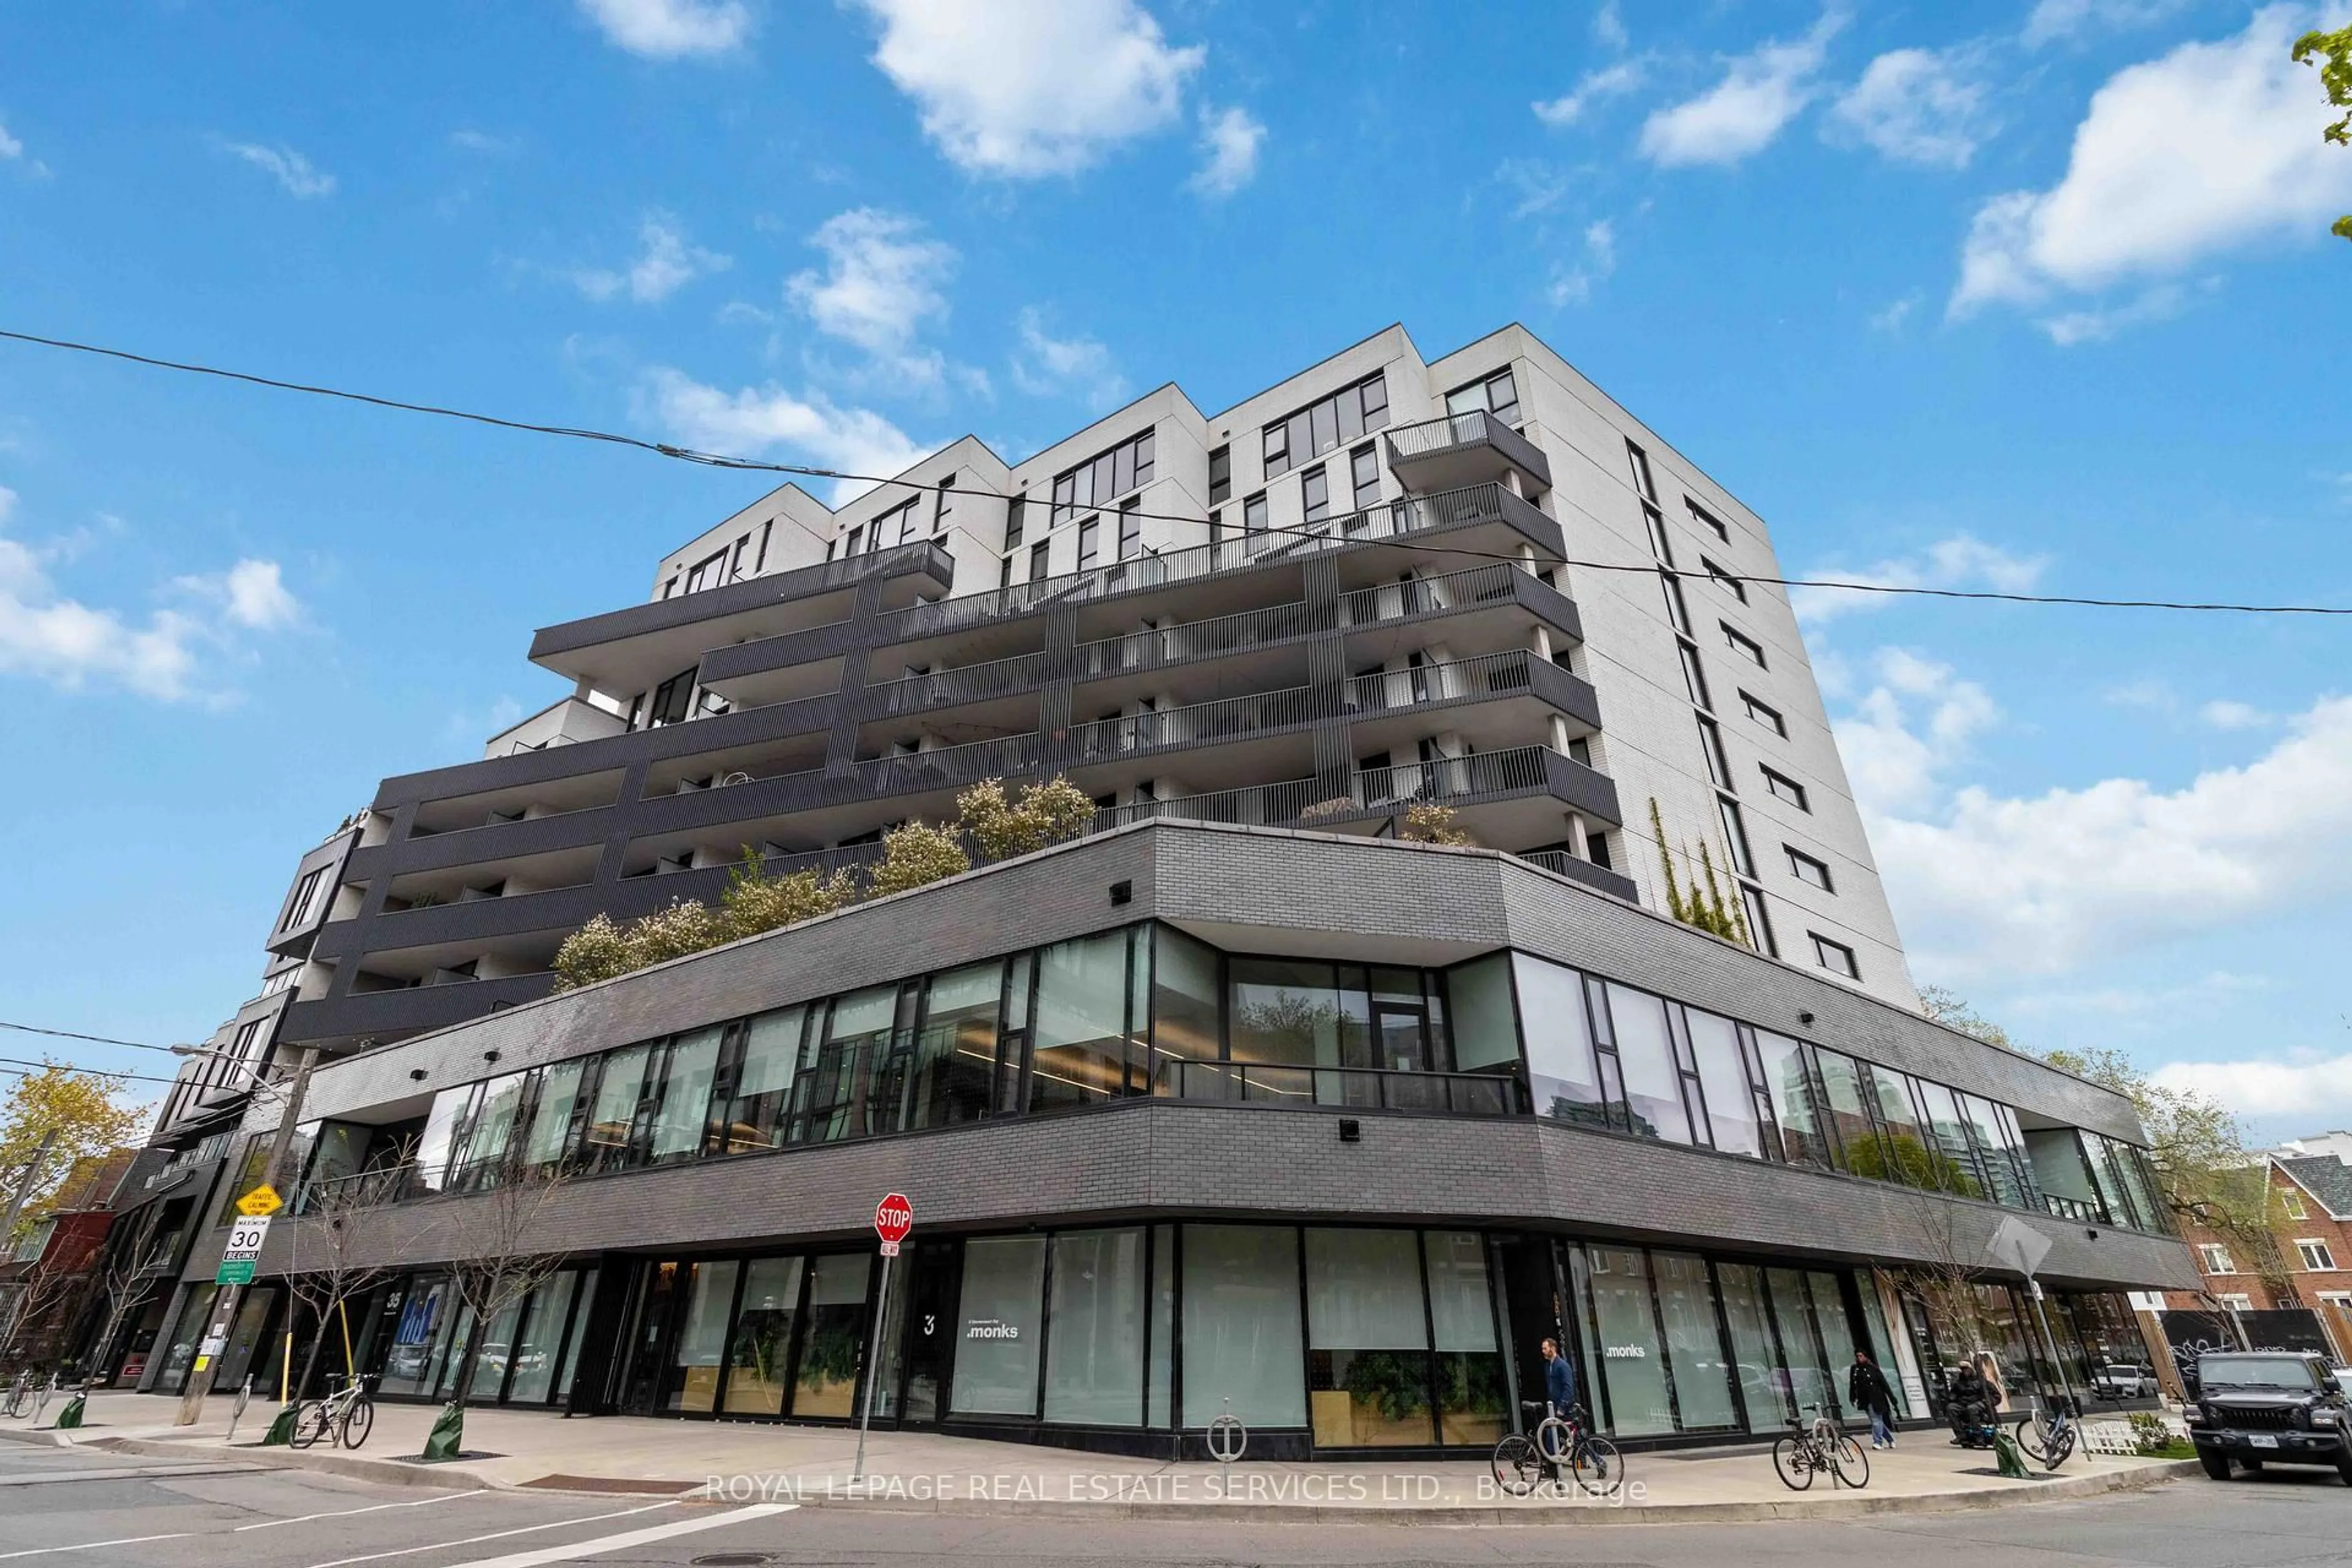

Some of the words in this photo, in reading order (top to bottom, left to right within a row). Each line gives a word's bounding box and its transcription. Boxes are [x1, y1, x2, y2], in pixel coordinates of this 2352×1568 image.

[878, 1208, 910, 1228] STOP
[232, 1231, 260, 1247] 30
[386, 1292, 402, 1308] 35
[967, 1324, 1018, 1338] .monks
[1606, 1343, 1645, 1357] .monks
